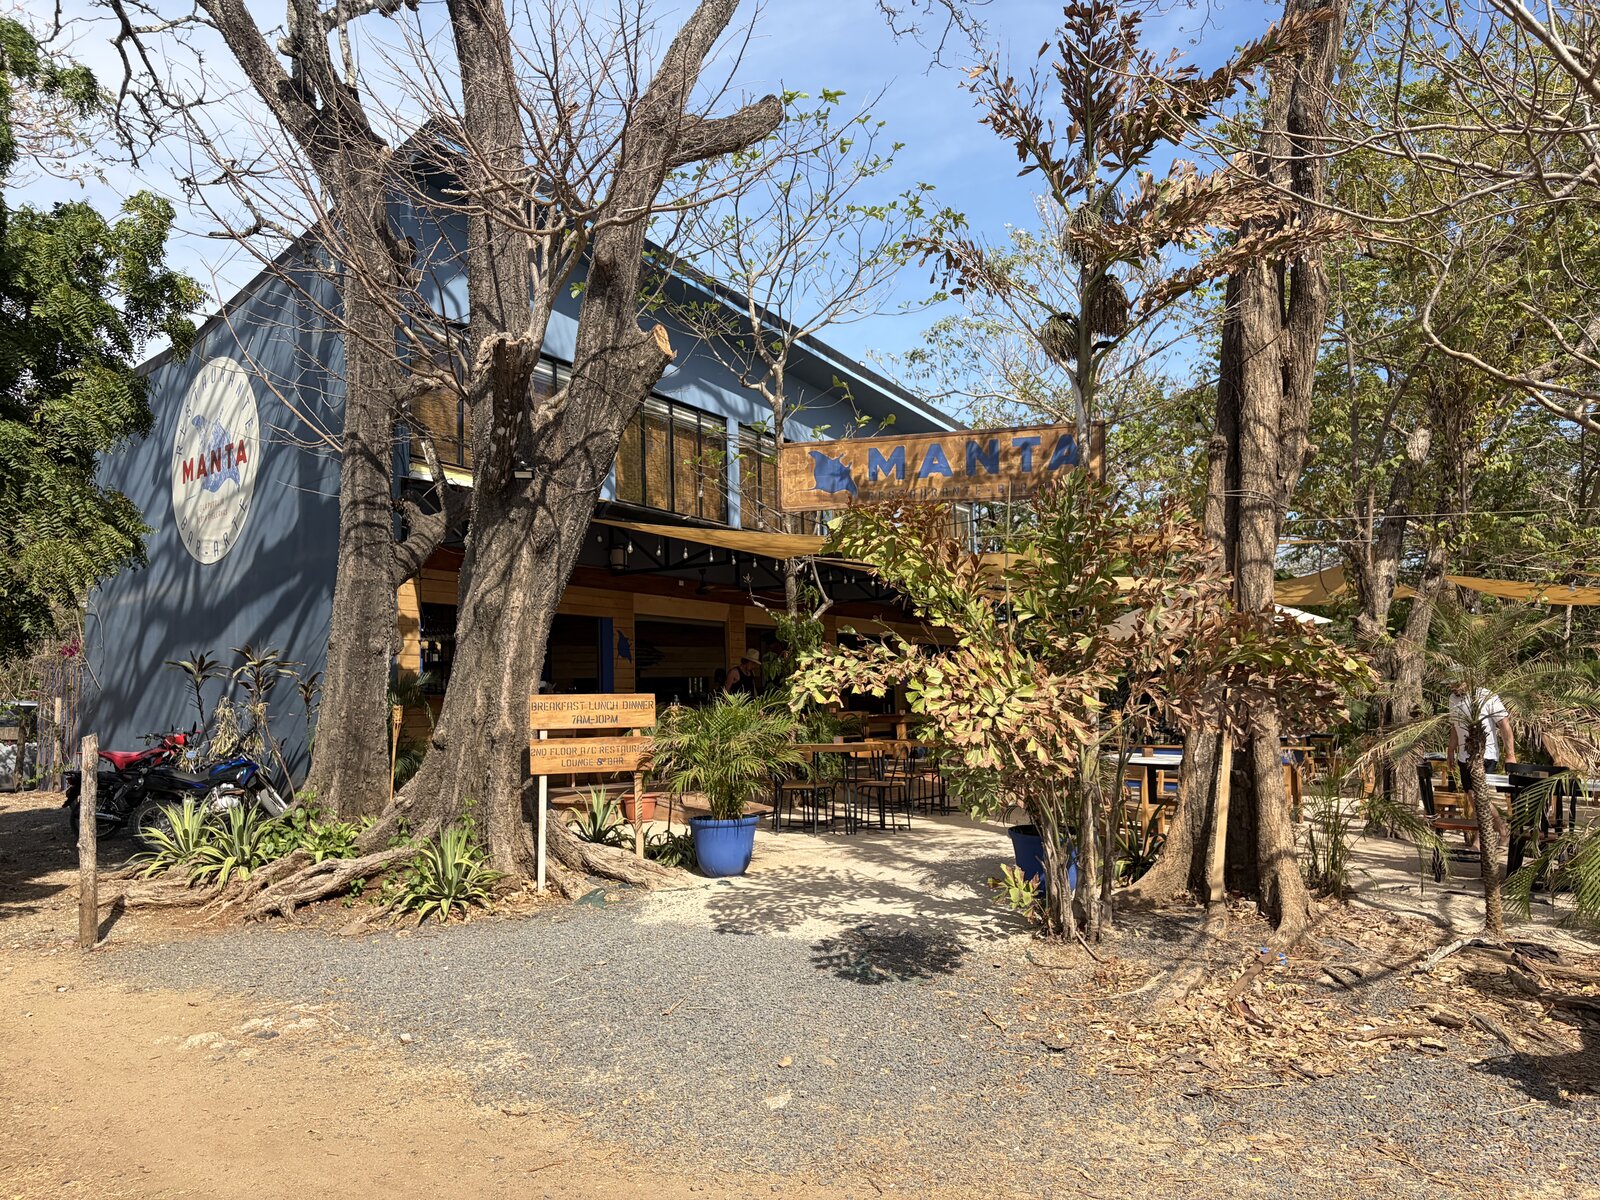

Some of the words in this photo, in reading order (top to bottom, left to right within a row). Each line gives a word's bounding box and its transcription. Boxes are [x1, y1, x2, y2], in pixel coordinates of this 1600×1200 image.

[176, 366, 254, 456] RESTAURANTE
[182, 439, 247, 485] MANTA
[868, 434, 1080, 481] MANTA
[531, 701, 586, 711] BREAKFAST
[588, 701, 619, 711] LUNCH
[622, 700, 654, 710] DINNER
[572, 714, 618, 724] 7AM-10PM
[530, 747, 547, 757] 2ND
[550, 747, 577, 756] FLOOR
[580, 746, 596, 756] A/C
[561, 757, 593, 767] LOUNGE
[596, 757, 606, 766] &
[607, 757, 624, 765] BAR
